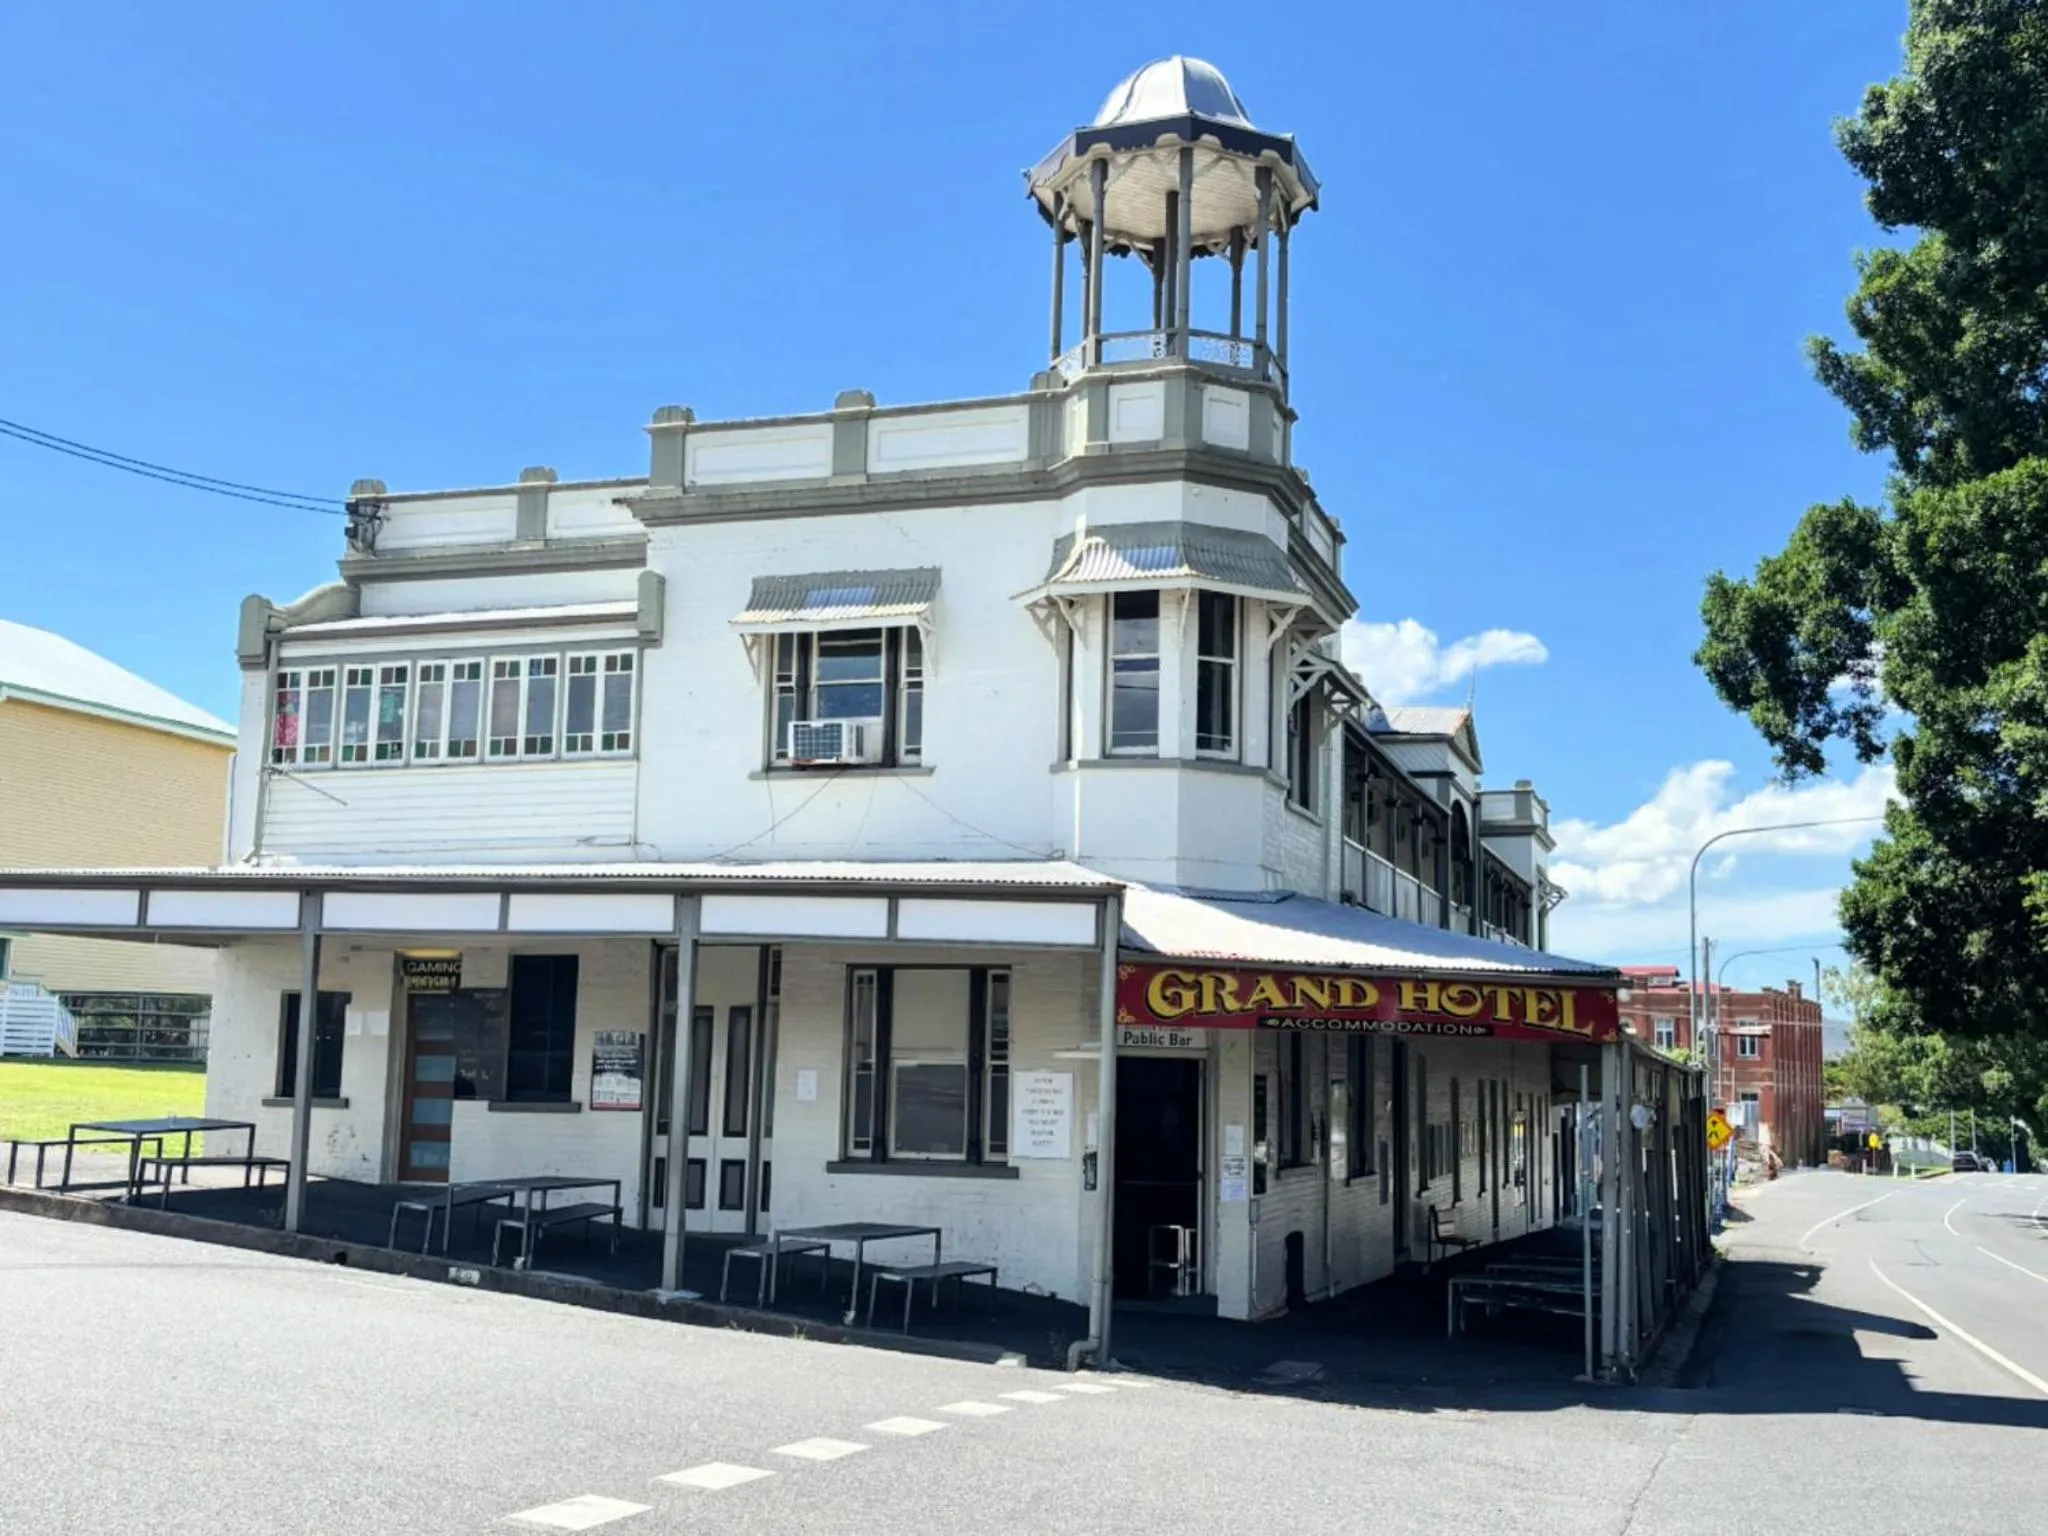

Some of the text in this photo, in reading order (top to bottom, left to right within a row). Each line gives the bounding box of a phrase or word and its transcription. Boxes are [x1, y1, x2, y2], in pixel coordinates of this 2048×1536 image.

[1146, 967, 1594, 1038] GRAND HOTEL
[1281, 1017, 1474, 1036] ACCOMMODATION
[1123, 1031, 1193, 1047] Public Bar
